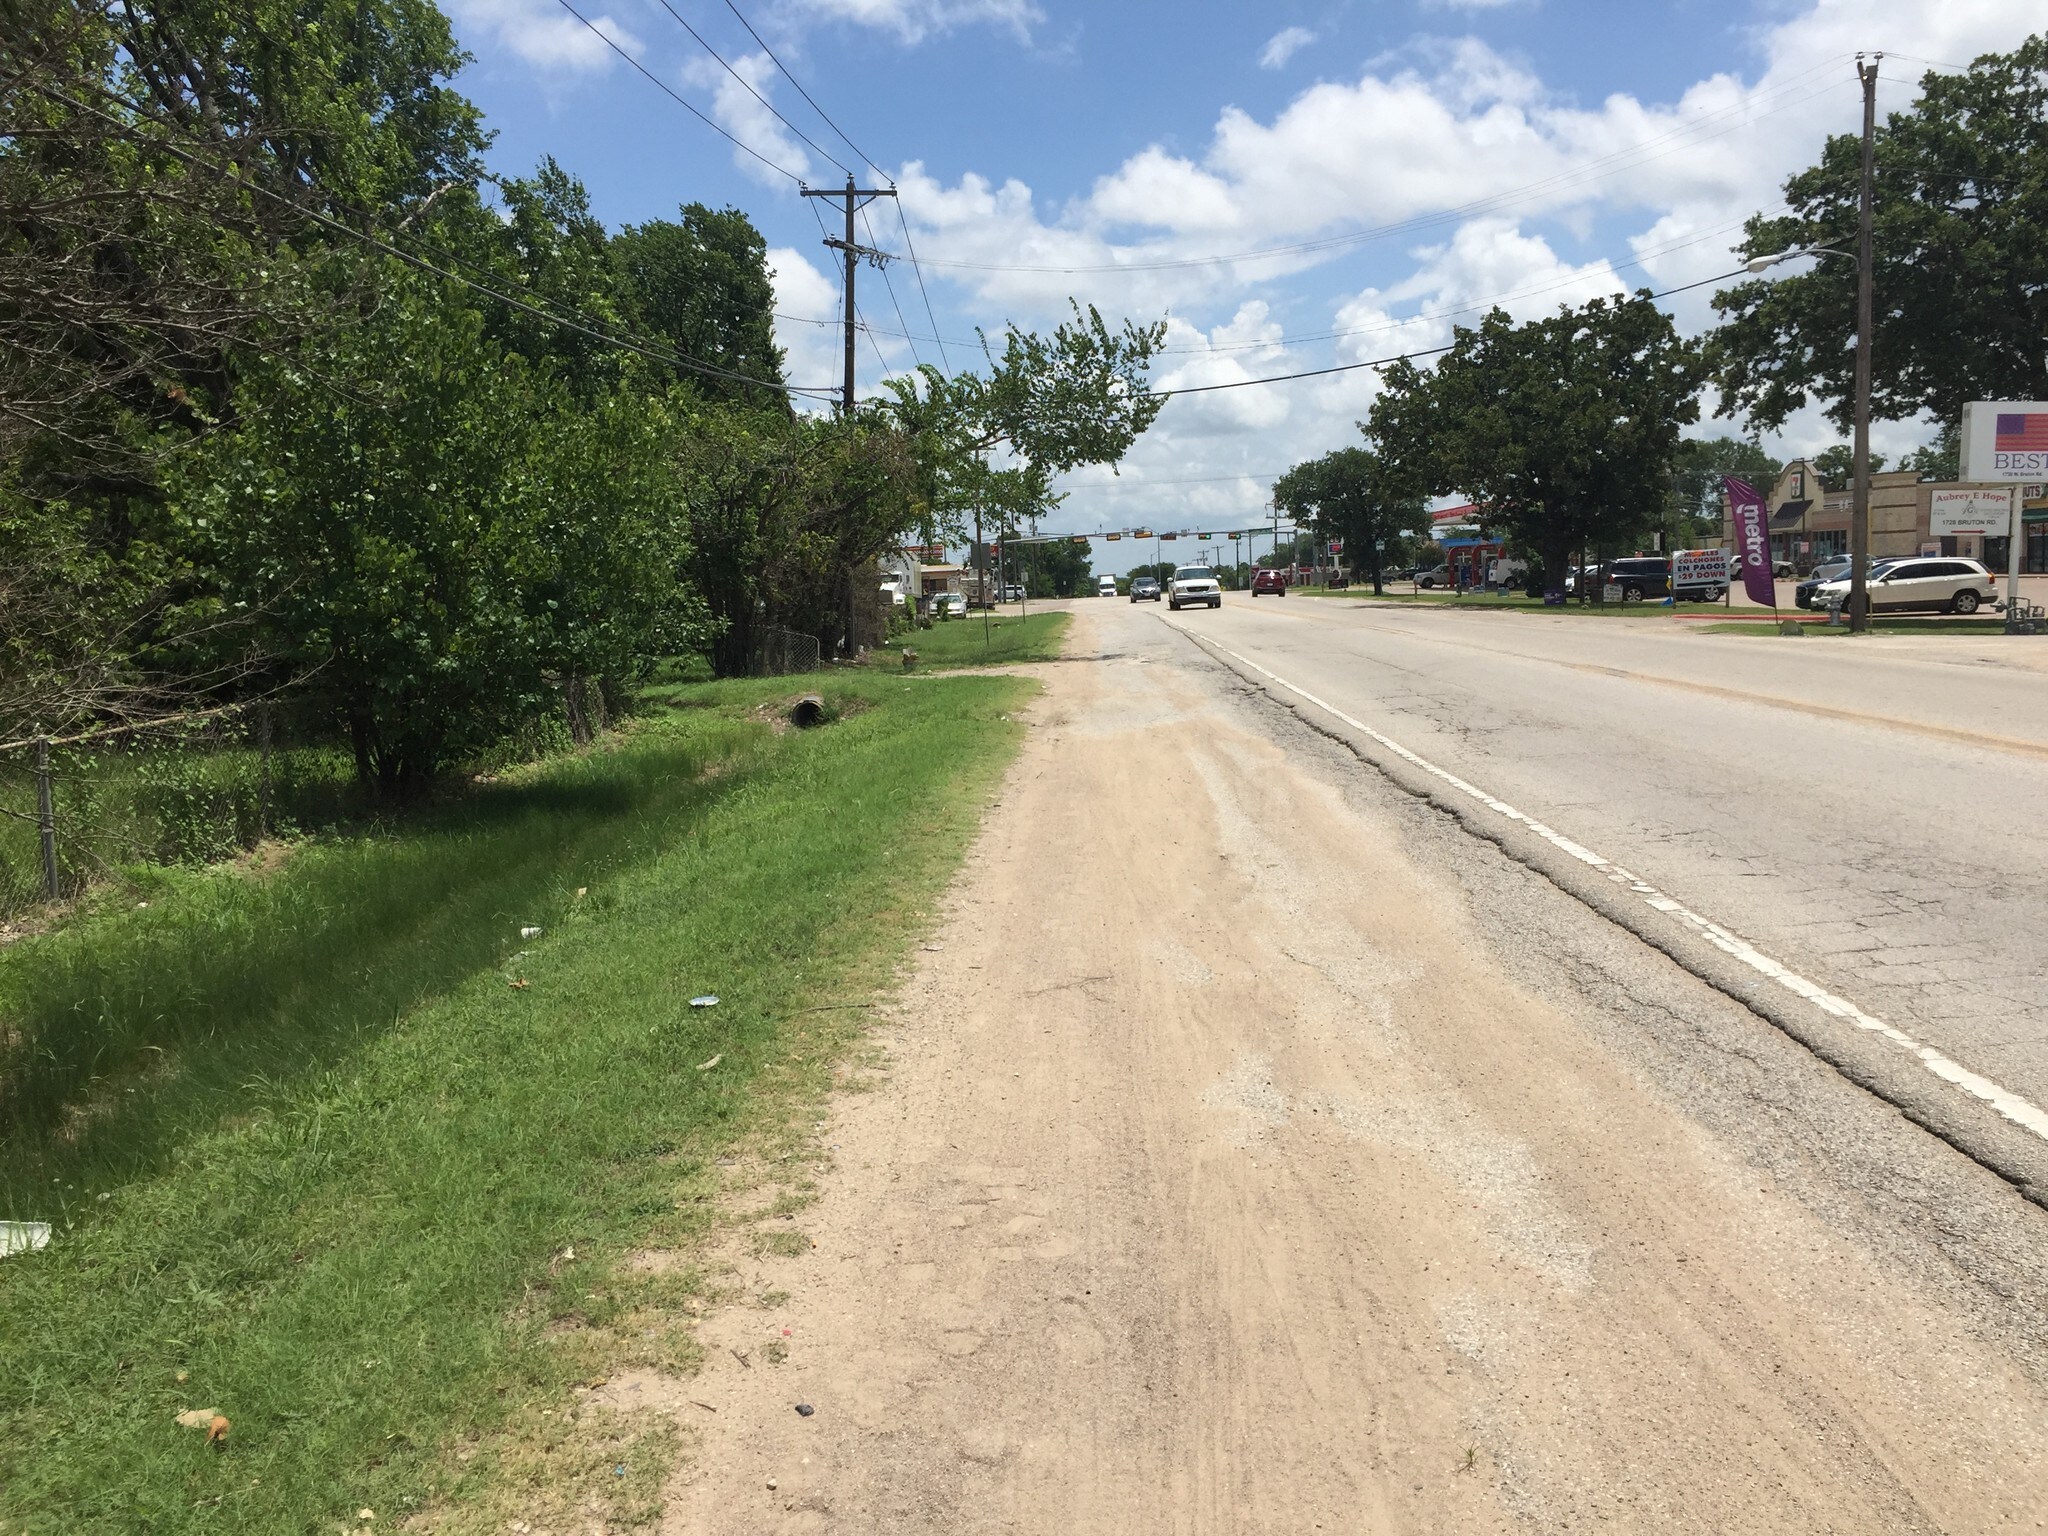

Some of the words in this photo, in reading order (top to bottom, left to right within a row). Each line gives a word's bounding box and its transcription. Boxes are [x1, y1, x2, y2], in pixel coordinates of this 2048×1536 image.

[1994, 453, 2048, 469] BEST
[1936, 493, 1970, 502] Aubrey
[1983, 492, 2007, 502] Hope
[1736, 503, 1764, 566] metro
[1678, 556, 1724, 564] COLCHONES
[1693, 562, 1726, 571] PAGOS
[1696, 570, 1726, 579] DOWN
